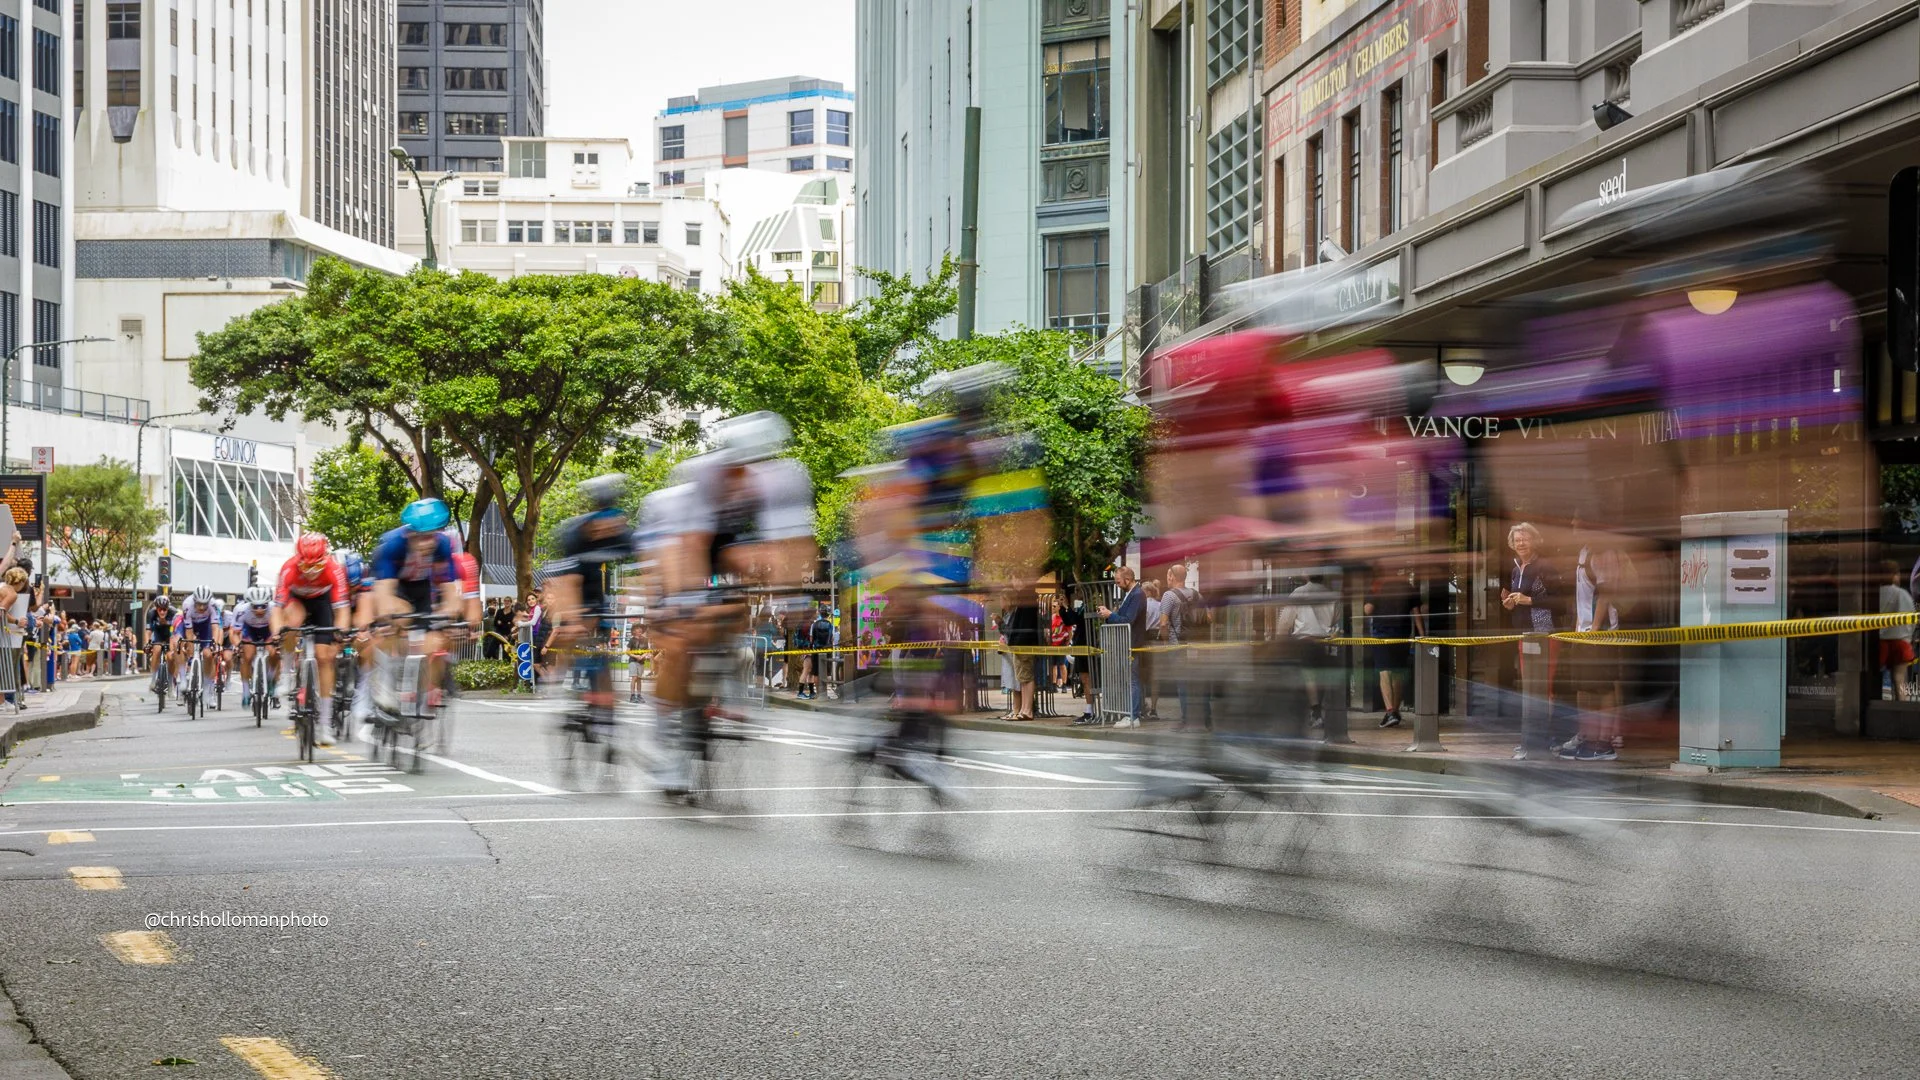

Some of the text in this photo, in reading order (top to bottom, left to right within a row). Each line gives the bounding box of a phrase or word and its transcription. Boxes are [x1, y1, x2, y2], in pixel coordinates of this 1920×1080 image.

[1302, 18, 1409, 115] HAMILTON CHAMBERS
[1599, 157, 1627, 207] seed
[1403, 415, 1501, 439] VANCE
[215, 436, 257, 464] EQUINOX
